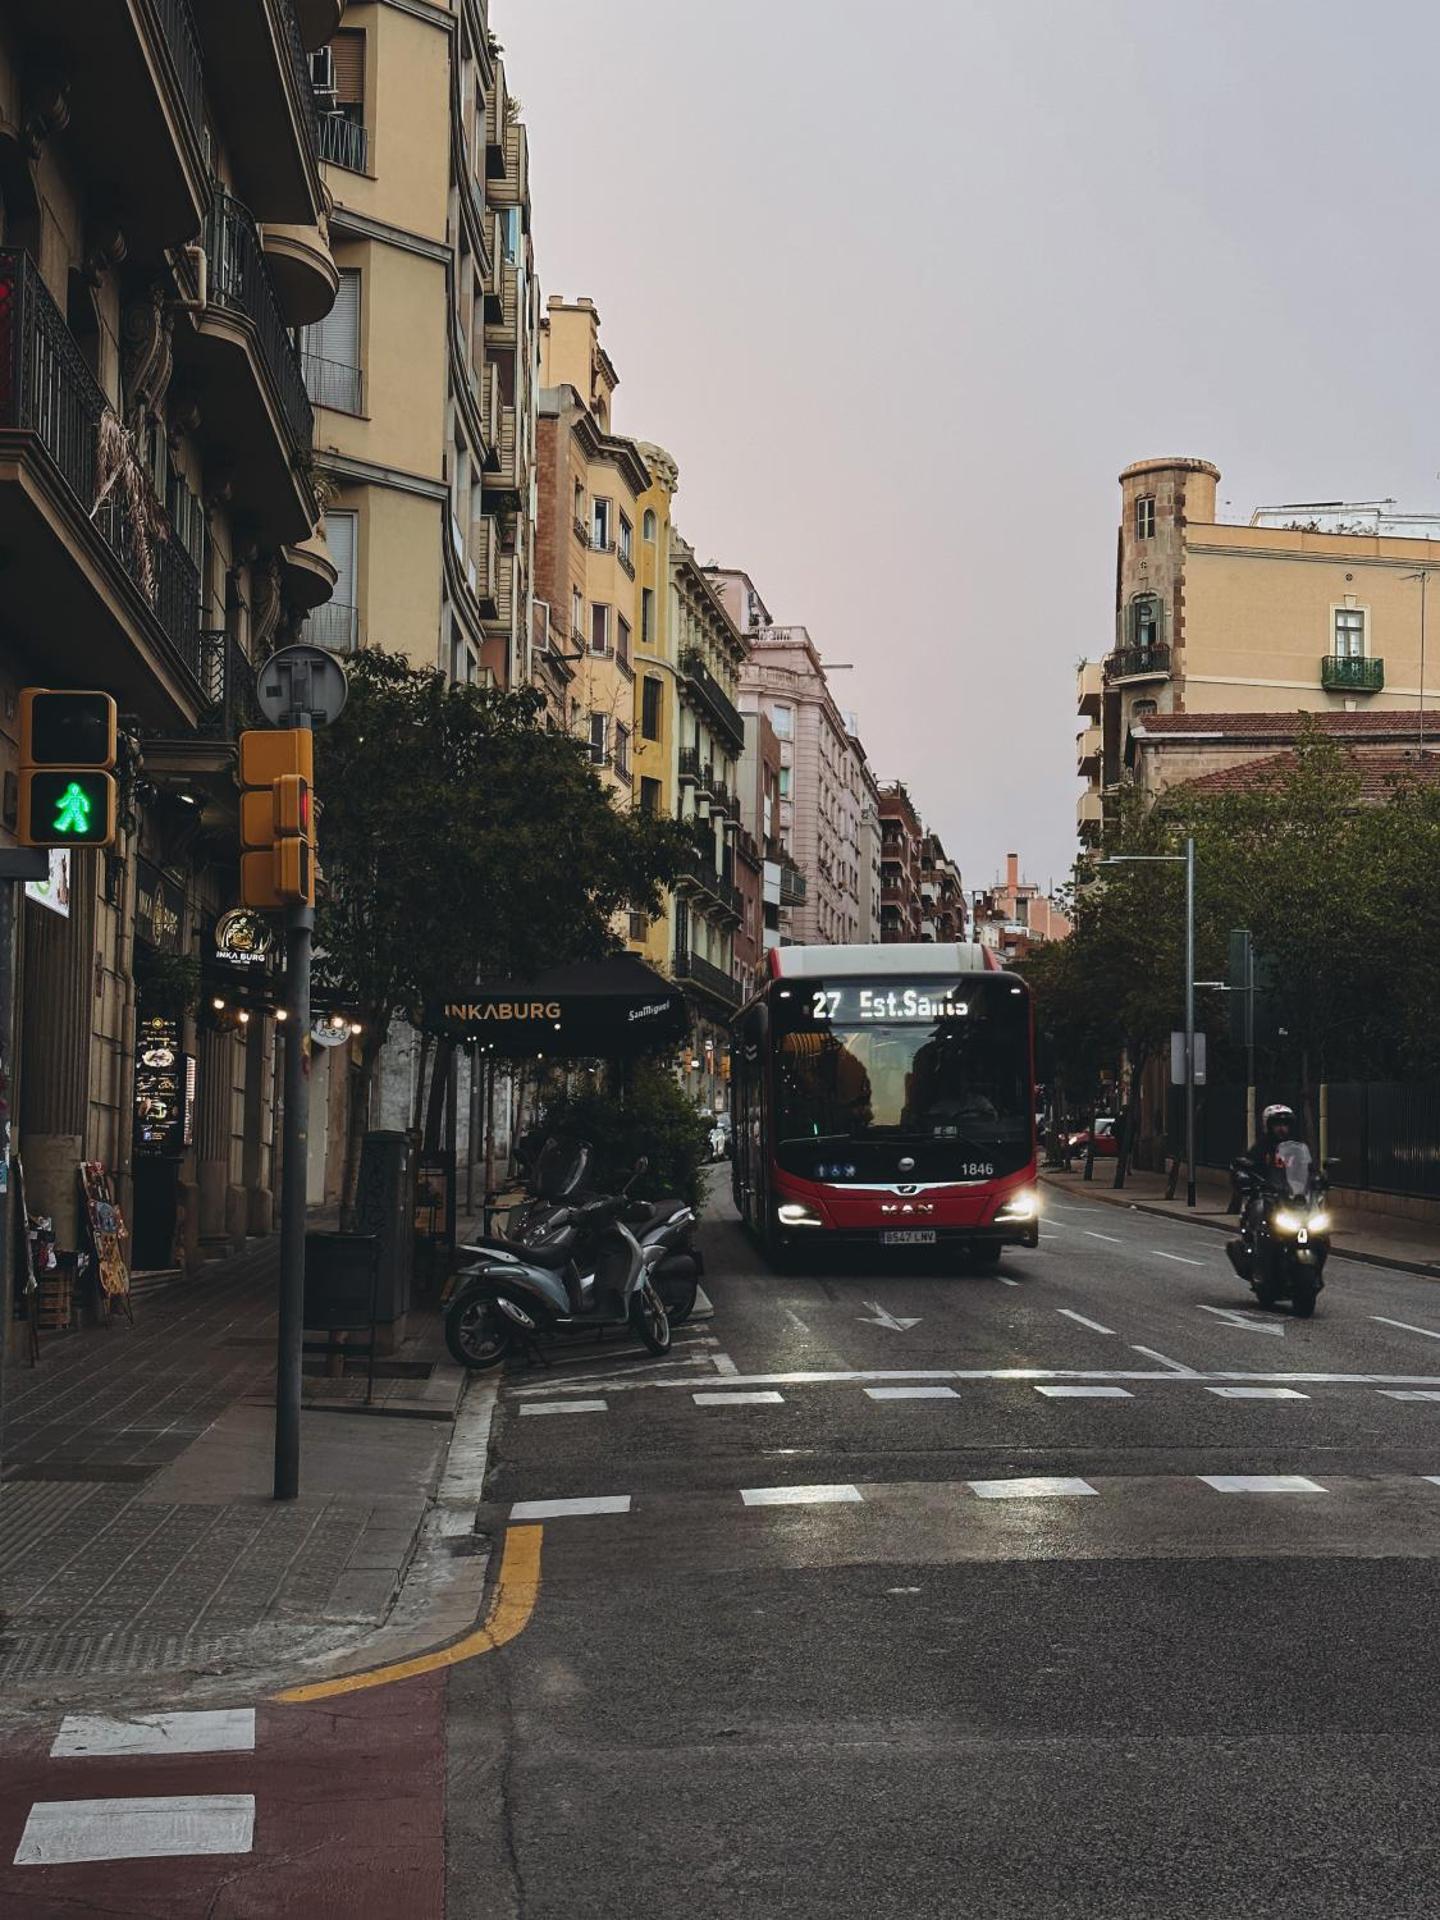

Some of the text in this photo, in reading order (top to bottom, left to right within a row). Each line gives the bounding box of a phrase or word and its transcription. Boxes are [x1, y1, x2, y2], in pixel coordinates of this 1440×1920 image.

[445, 1002, 561, 1020] INKABURG
[812, 991, 842, 1019] 27
[961, 1163, 994, 1176] 1846
[881, 1203, 934, 1215] MAN
